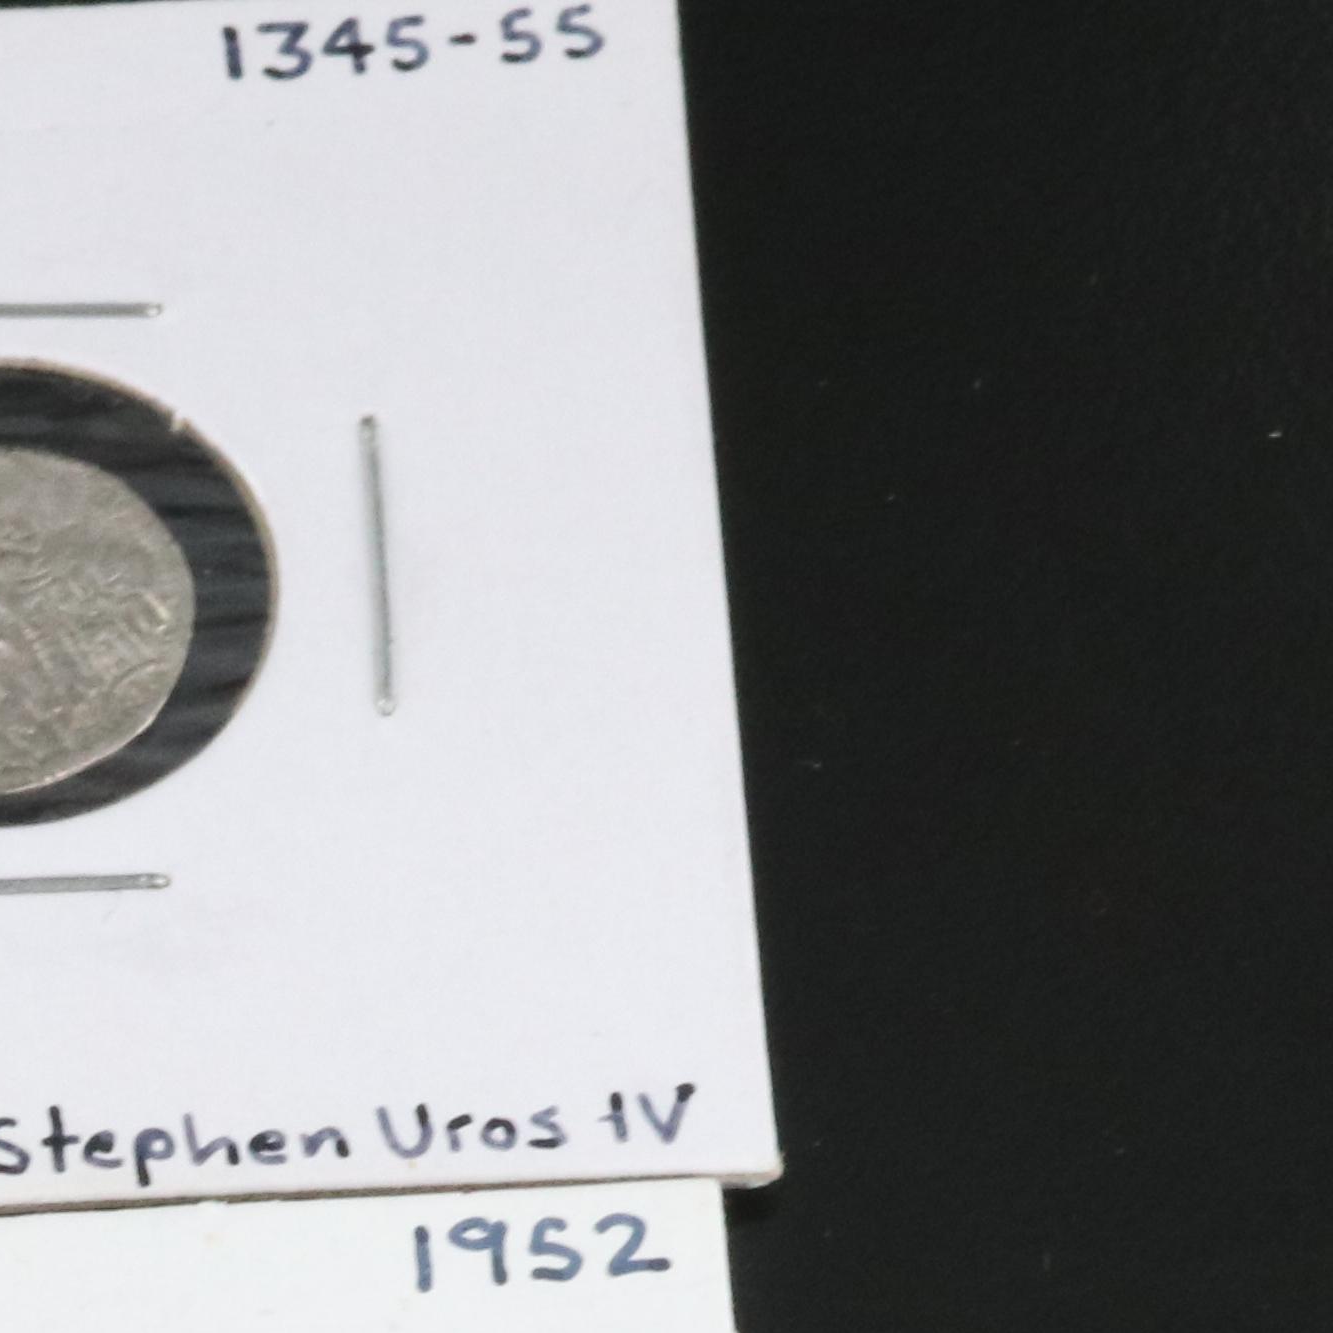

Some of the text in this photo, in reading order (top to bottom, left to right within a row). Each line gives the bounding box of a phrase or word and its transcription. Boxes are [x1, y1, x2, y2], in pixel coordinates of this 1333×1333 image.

[222, 6, 604, 81] 1345-55
[377, 1103, 567, 1159] Uros
[414, 1213, 671, 1293] 1952
